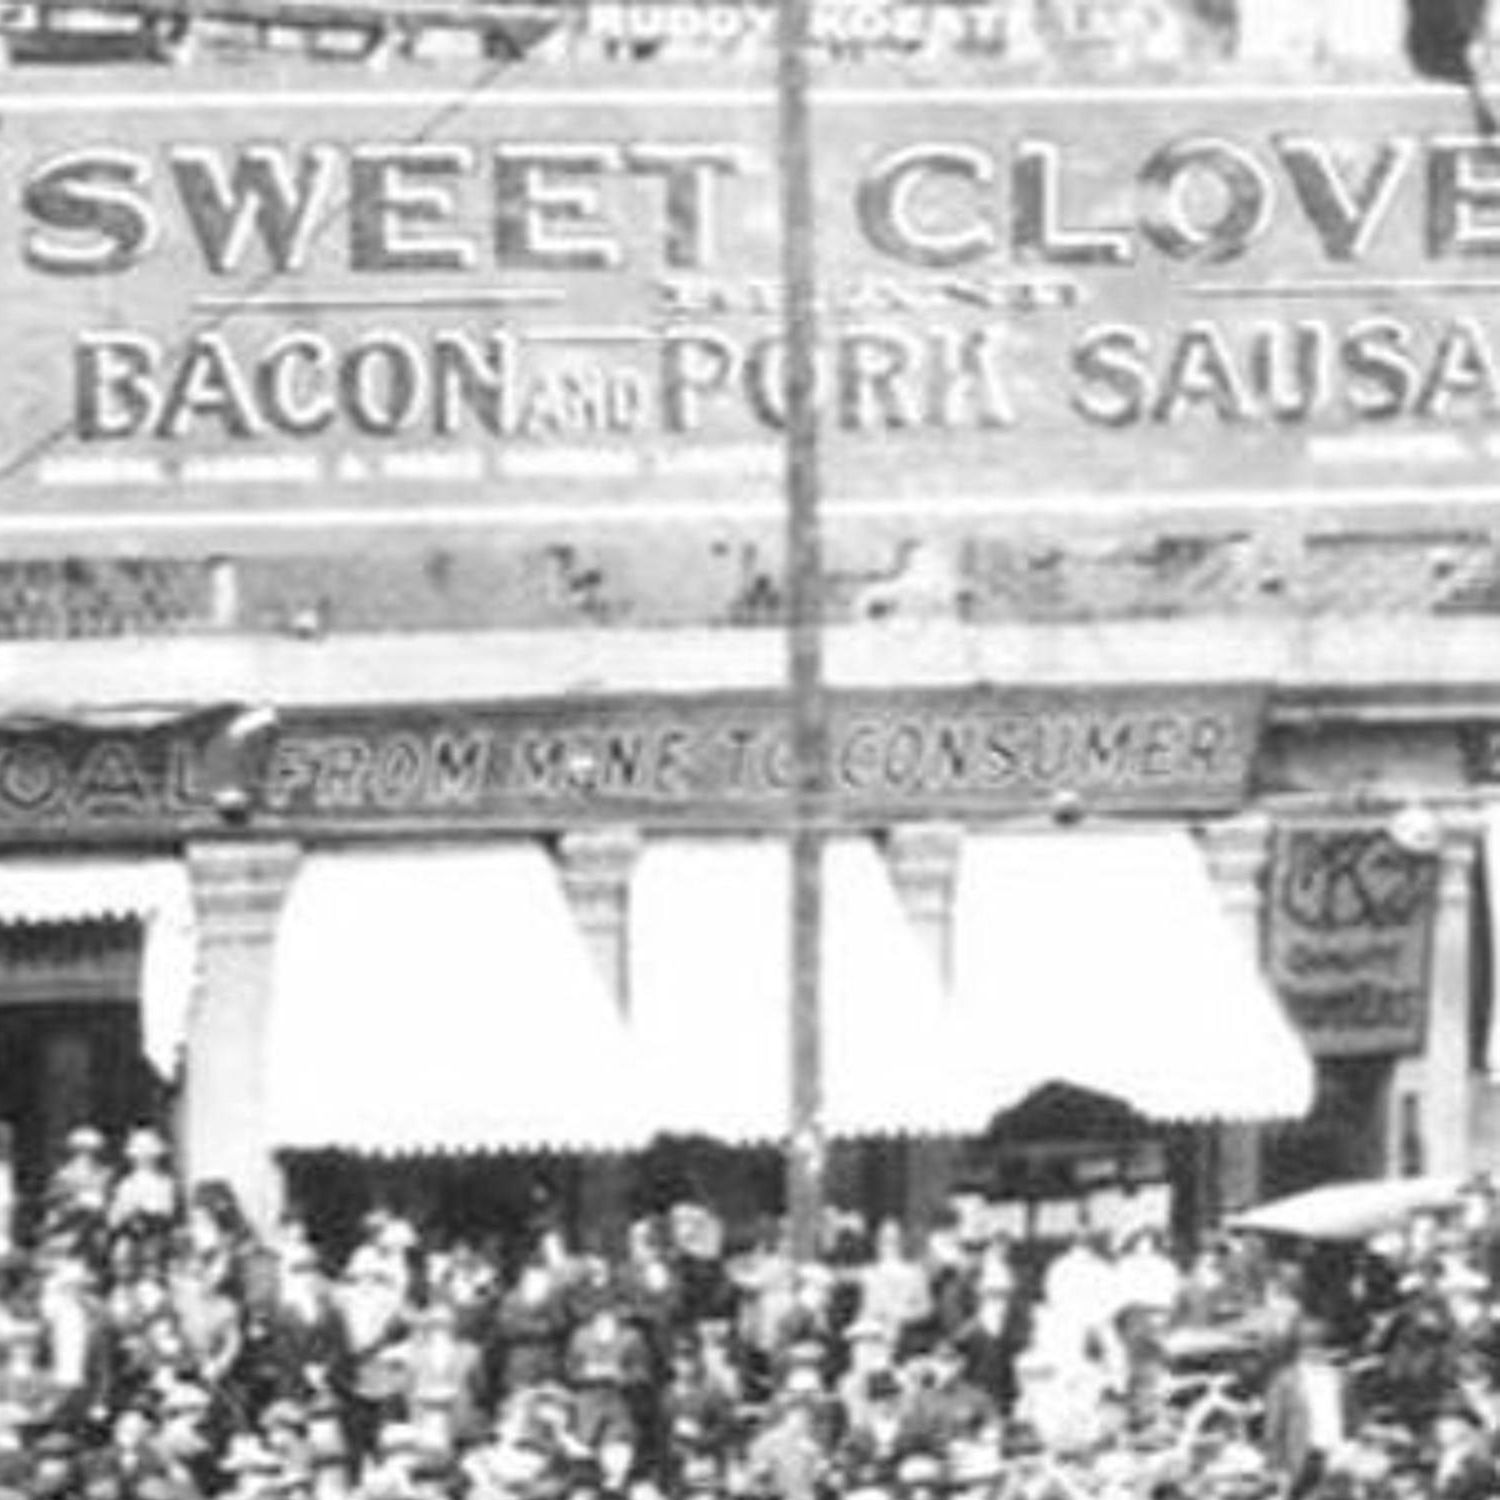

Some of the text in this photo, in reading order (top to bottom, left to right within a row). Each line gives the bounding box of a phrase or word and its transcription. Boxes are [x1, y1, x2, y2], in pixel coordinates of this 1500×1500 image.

[23, 134, 1500, 275] SWEET CLOVE
[72, 318, 1500, 441] BACON AND PORK SAUSA
[275, 732, 496, 804] FROM
[838, 714, 1232, 790] CONSUMER
